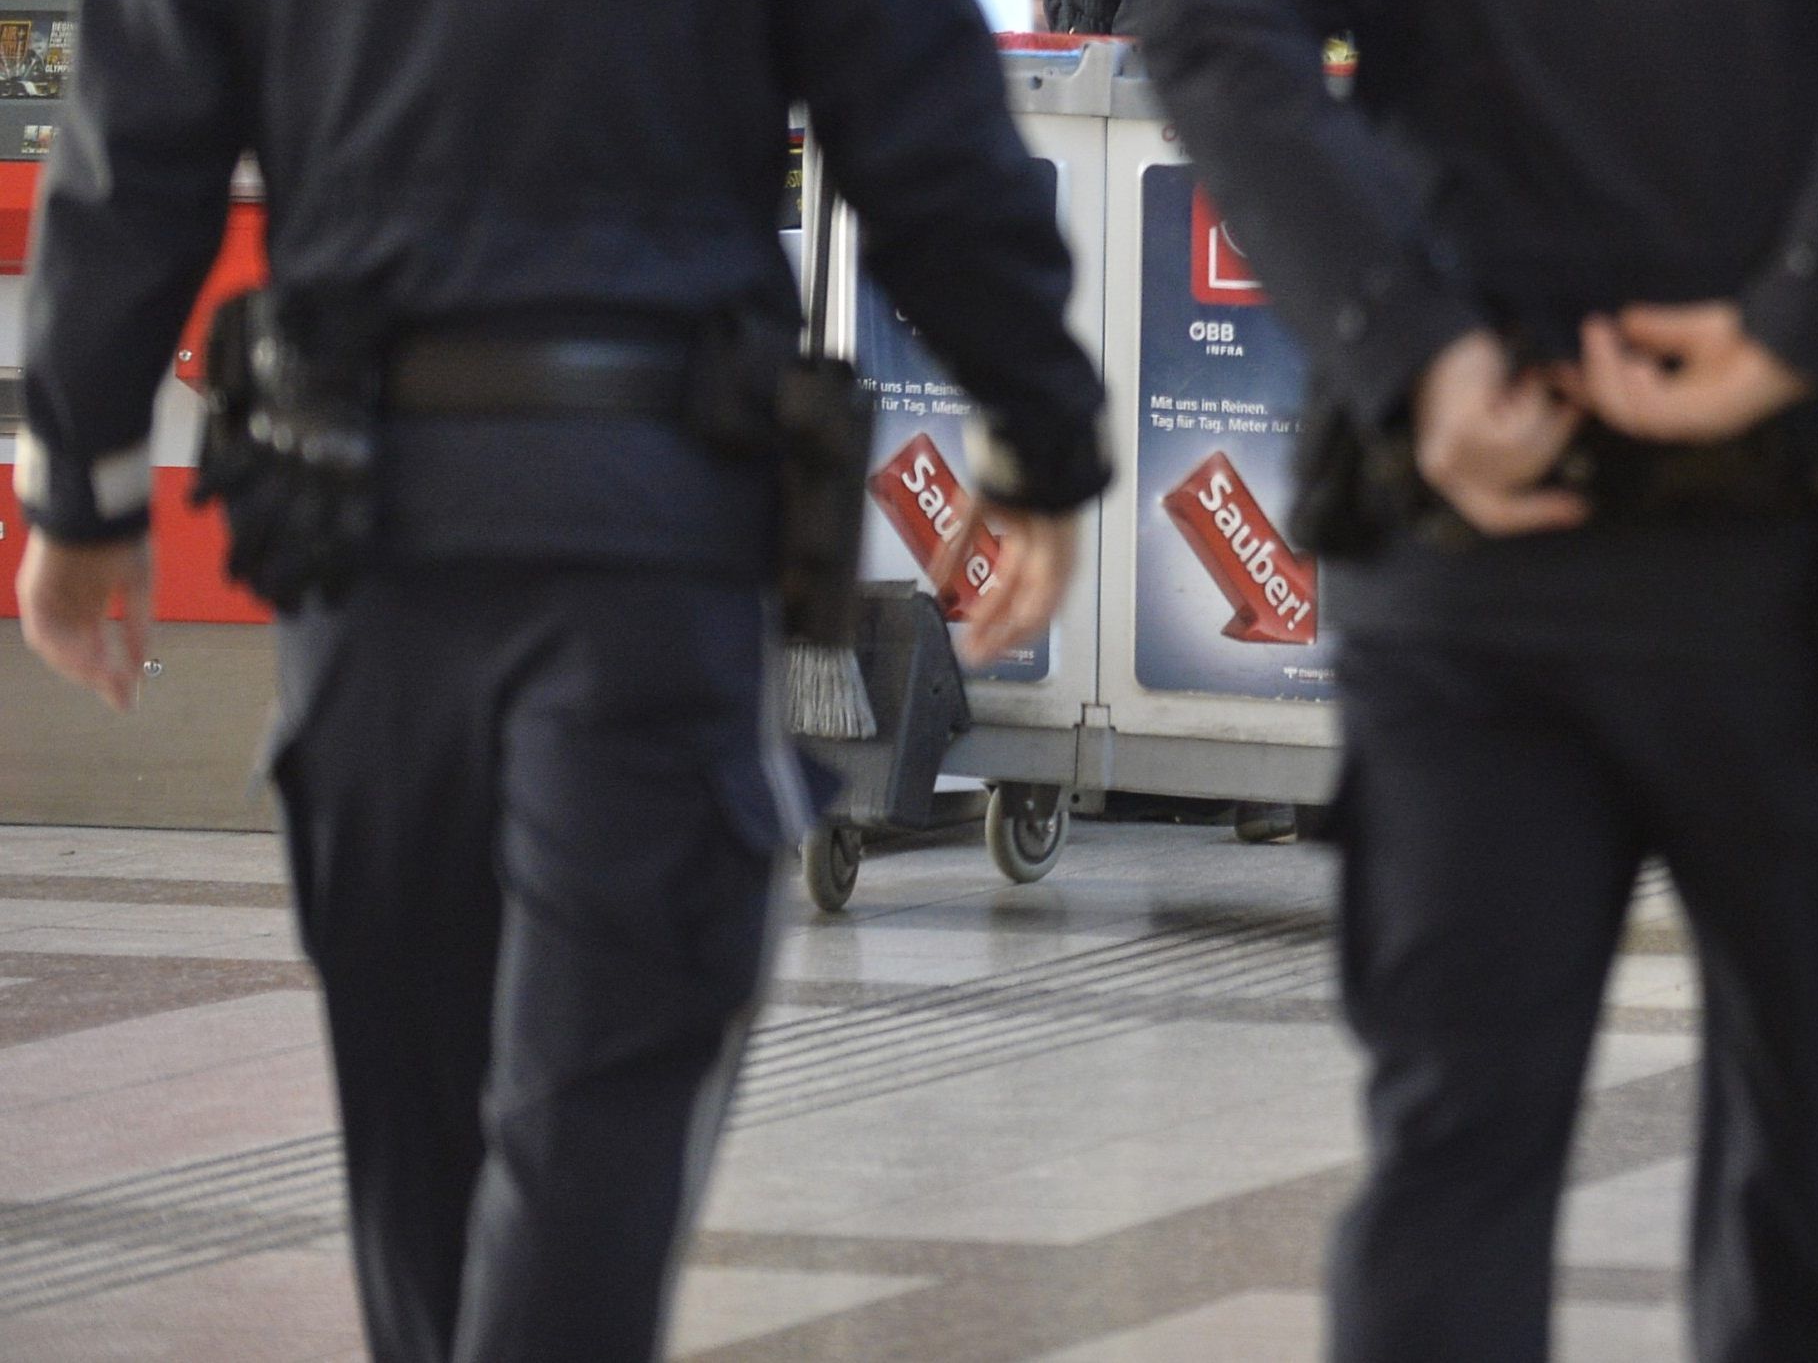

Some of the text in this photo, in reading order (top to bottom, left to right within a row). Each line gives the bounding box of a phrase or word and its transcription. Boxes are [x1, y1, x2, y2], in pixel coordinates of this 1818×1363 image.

[1206, 345, 1243, 357] INFRA
[880, 382, 902, 394] uns
[906, 381, 921, 394] im
[881, 397, 899, 411] für
[903, 398, 928, 416] Tag.
[931, 401, 972, 416] Meter
[1151, 395, 1268, 415] Mit uns im Reinen.
[1151, 414, 1174, 431] Tag
[1177, 414, 1194, 429] für
[1198, 416, 1225, 434] Tag.
[1228, 418, 1267, 433] Meter
[1198, 473, 1311, 631] Sauber!
